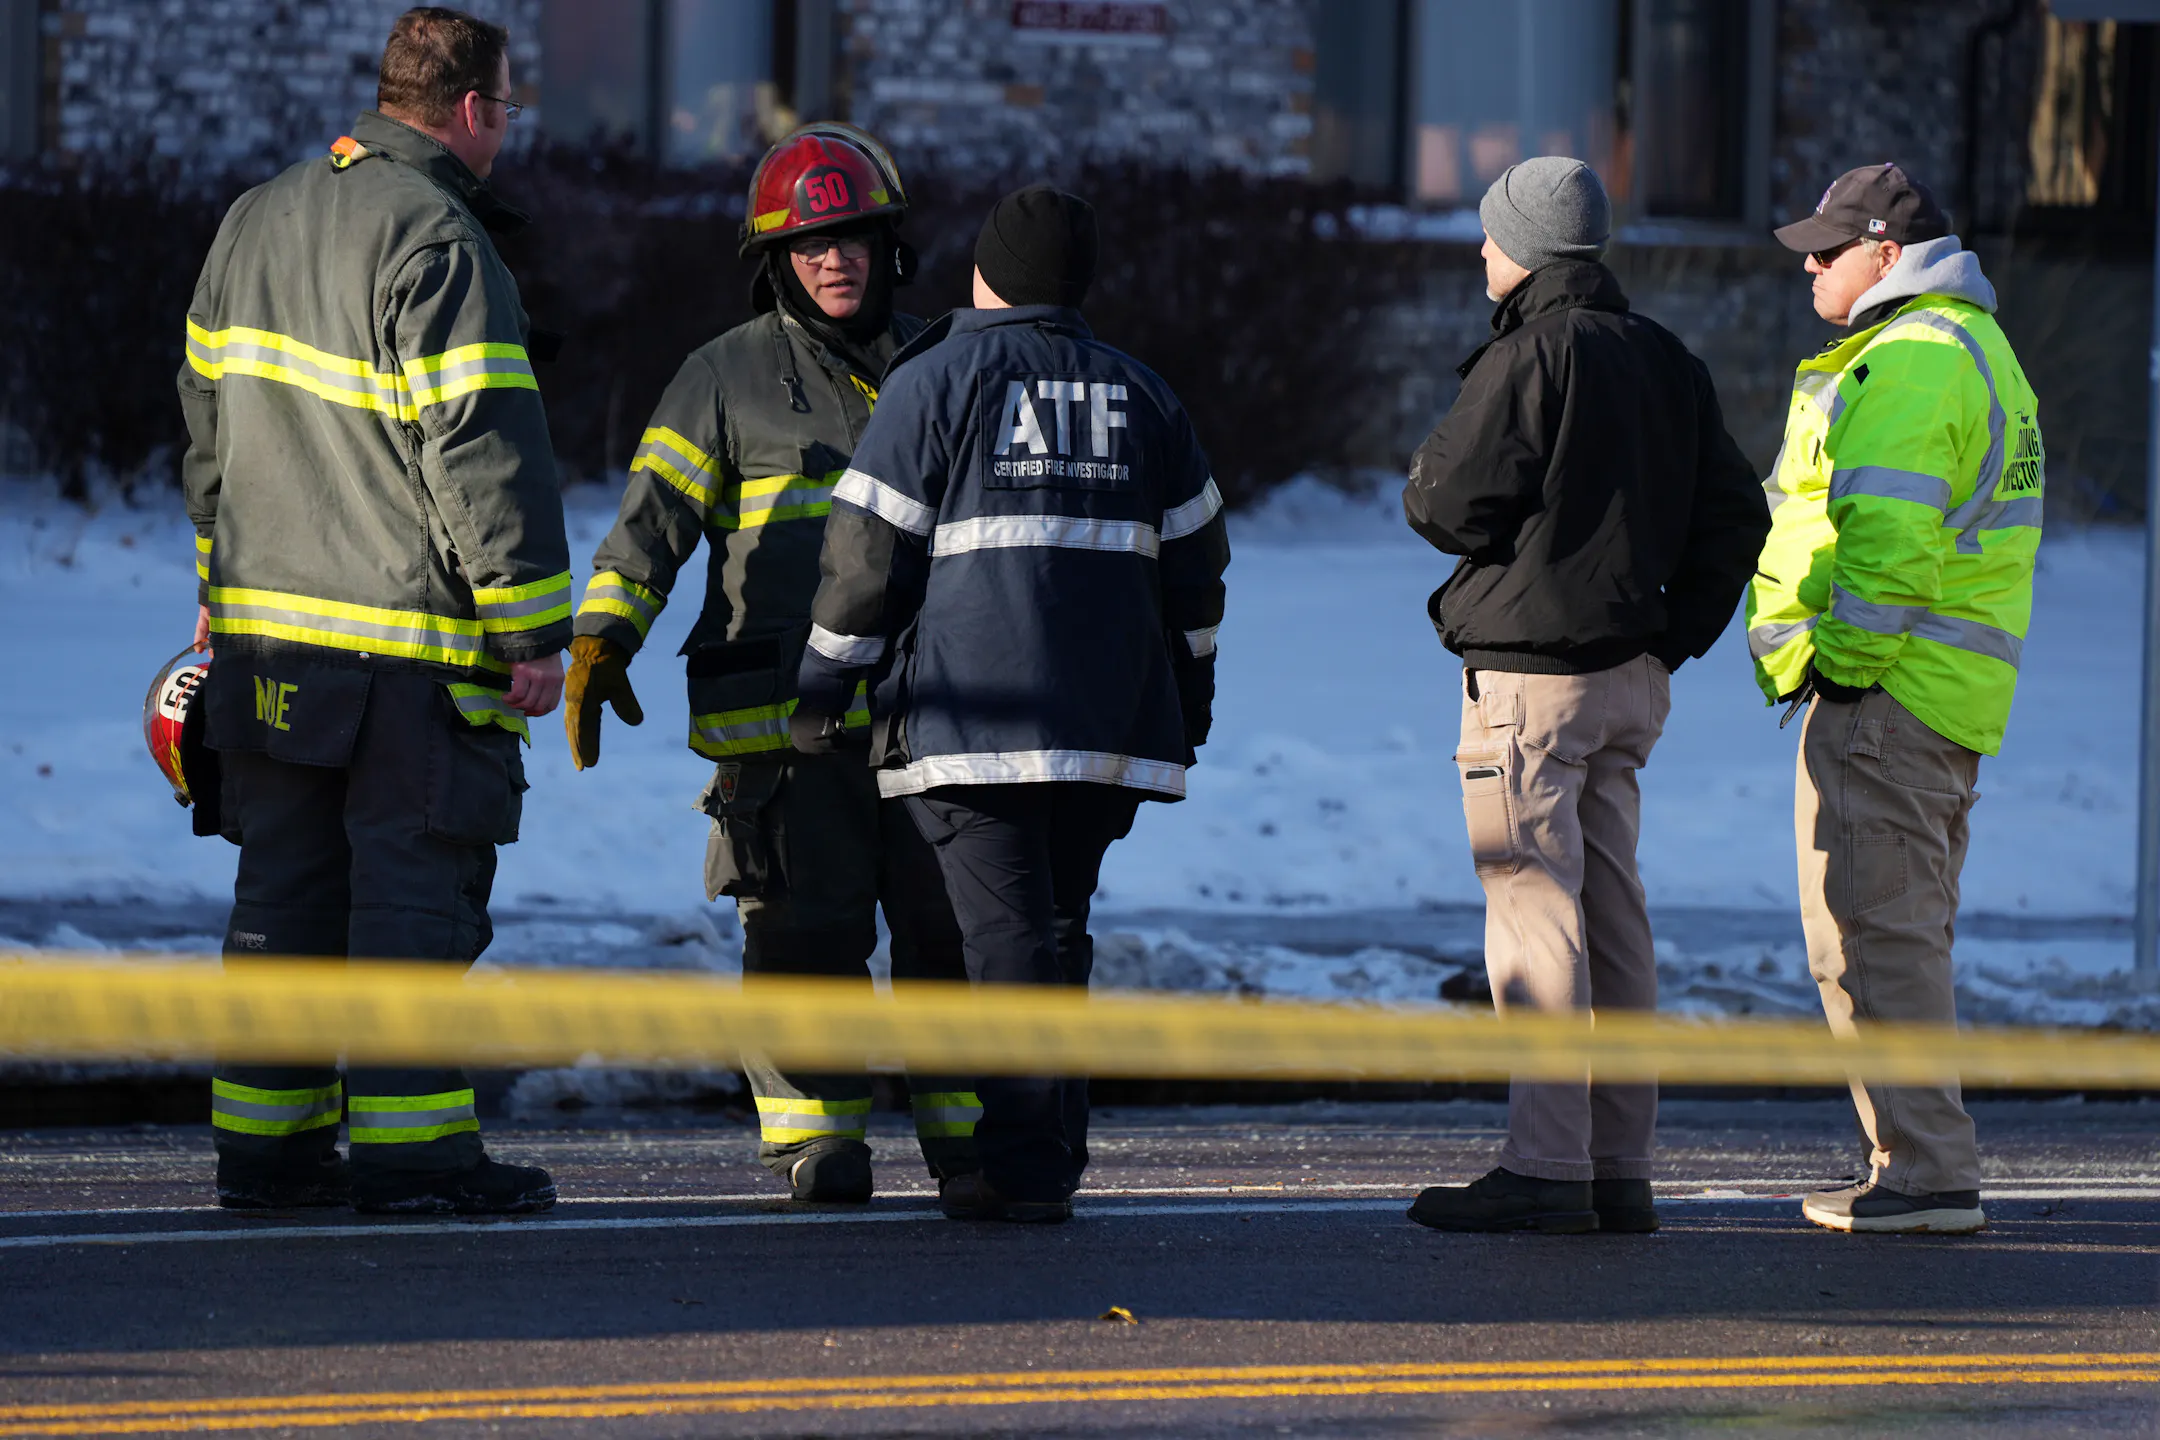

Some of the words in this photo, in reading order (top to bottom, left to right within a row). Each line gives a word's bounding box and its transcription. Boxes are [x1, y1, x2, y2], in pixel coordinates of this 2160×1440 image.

[804, 172, 849, 213] 50
[993, 380, 1129, 457] ATF
[994, 459, 1043, 478] CERTIFIED
[1044, 459, 1065, 476] FIRE
[164, 672, 206, 711] 50
[240, 932, 266, 942] INNO
